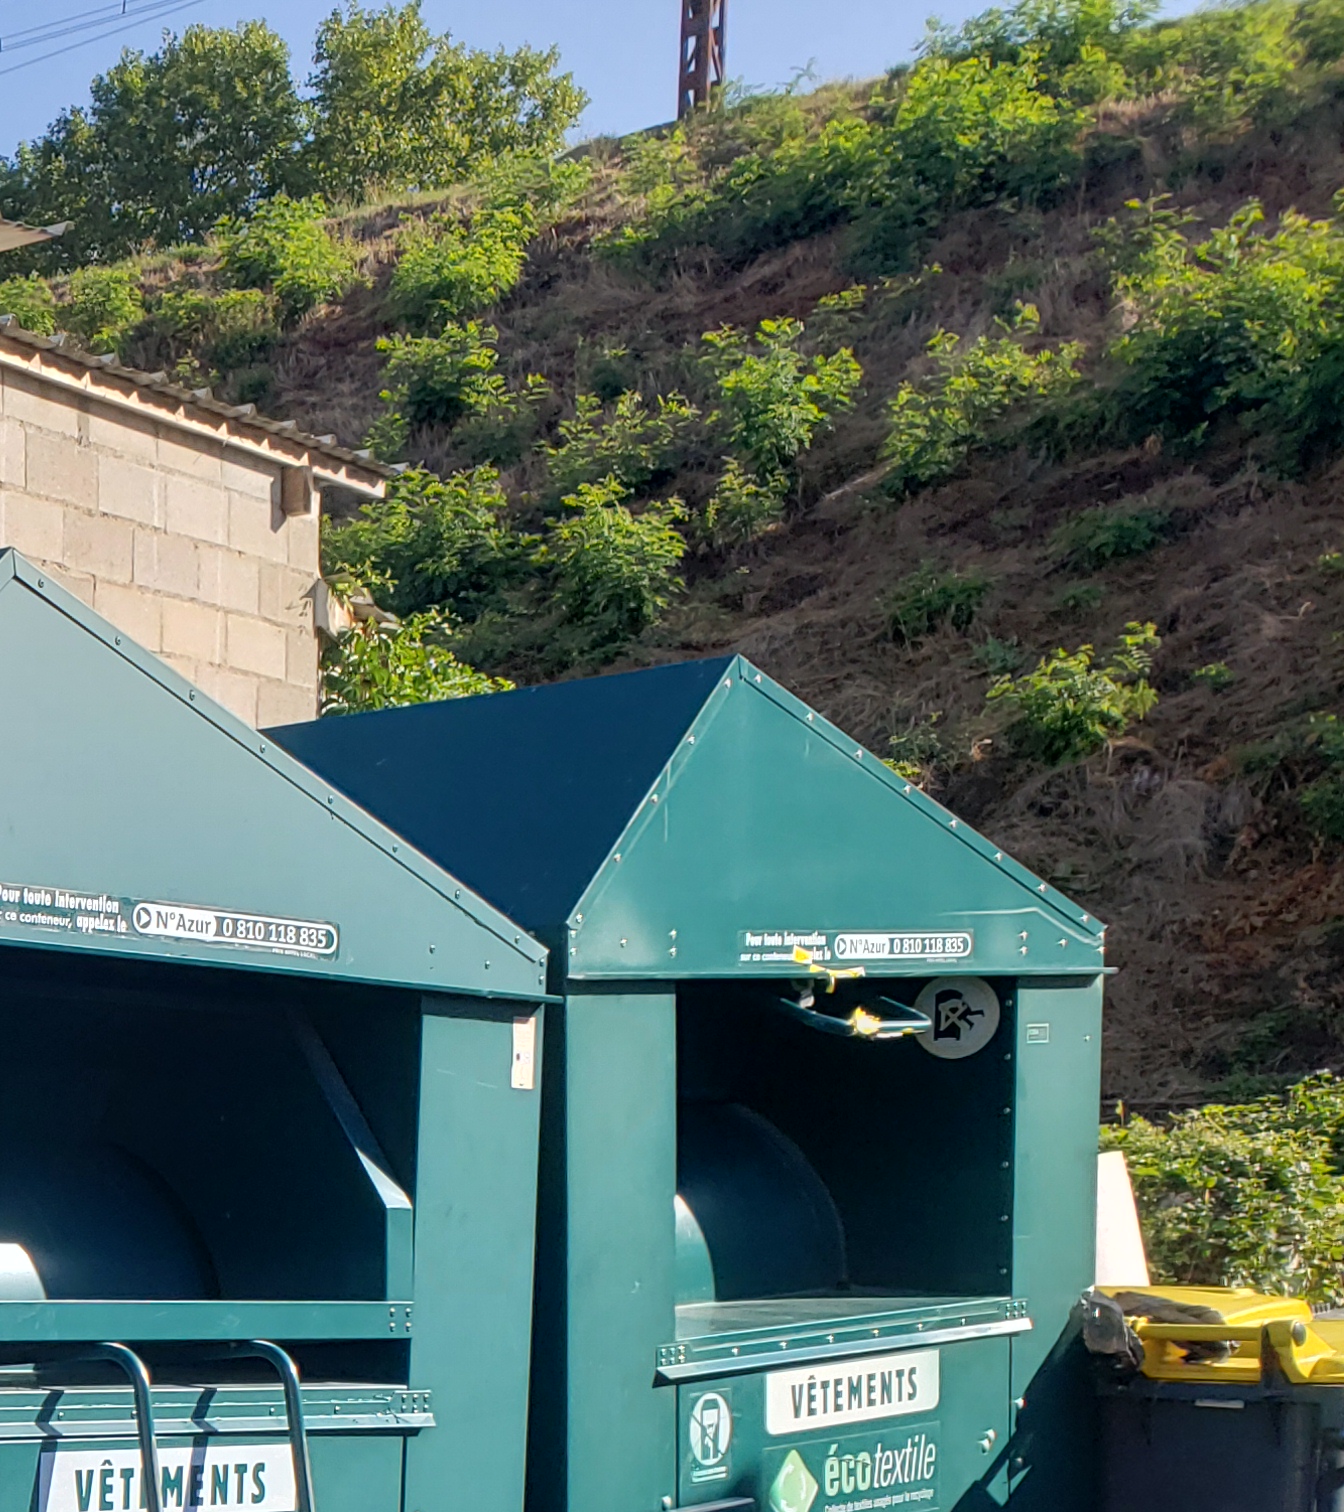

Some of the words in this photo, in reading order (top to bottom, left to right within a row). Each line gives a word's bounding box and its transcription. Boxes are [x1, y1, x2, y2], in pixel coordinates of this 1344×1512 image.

[222, 919, 233, 937] 0
[236, 920, 264, 940] 810
[268, 924, 296, 943] 118
[299, 927, 327, 947] 835
[903, 939, 922, 953] 810
[925, 938, 943, 953] 118
[945, 937, 964, 952] 835
[791, 1366, 917, 1419] VÊTEMENTS
[75, 1459, 265, 1512] VÊTMENTS
